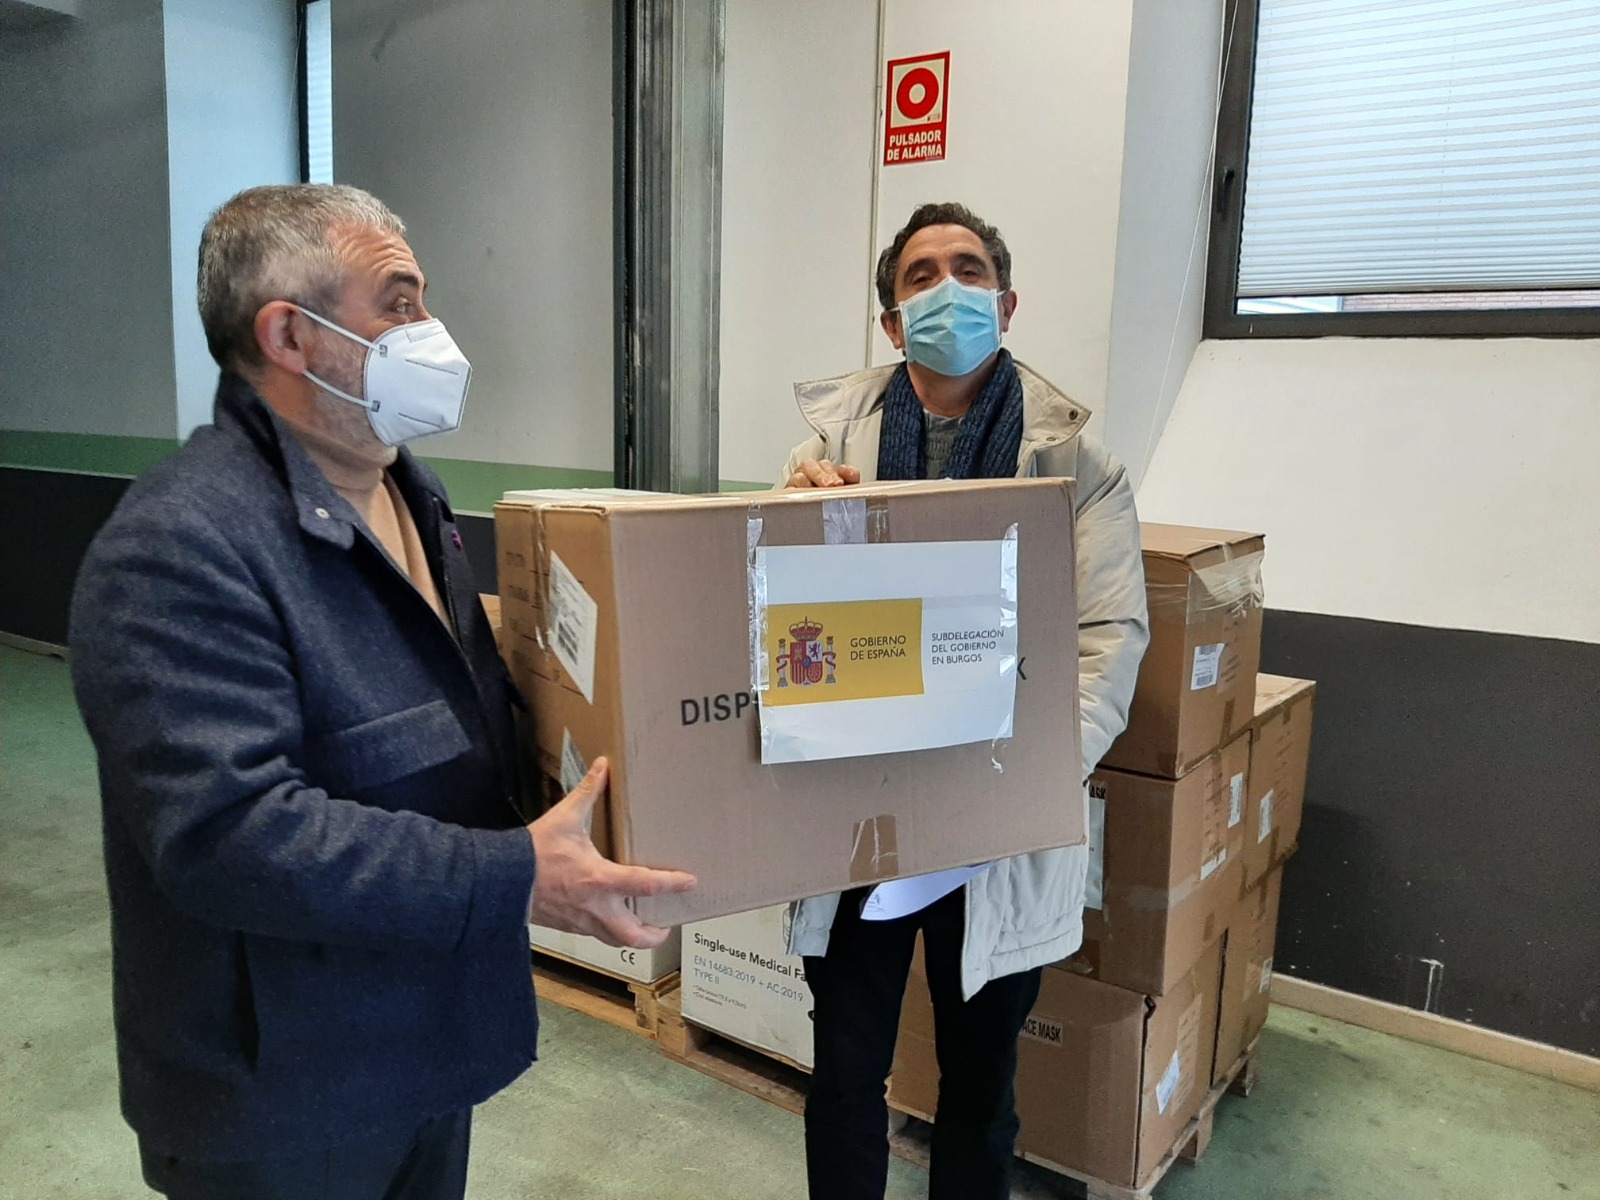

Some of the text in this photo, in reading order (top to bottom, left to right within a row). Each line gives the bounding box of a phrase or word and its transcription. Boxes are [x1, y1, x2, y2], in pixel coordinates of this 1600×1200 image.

[889, 129, 942, 147] PULSADOR
[886, 143, 943, 161] DE ALARMA
[850, 634, 907, 648] GOBIERNO
[931, 629, 1005, 641] SUBDELEGACIÓN
[850, 645, 907, 661] DE ESPAÑA
[931, 640, 997, 653] DEL GOBIERNO
[931, 653, 983, 665] EN BURGOS
[680, 691, 760, 727] DISP
[620, 949, 636, 966] CE
[694, 932, 747, 961] Single-use
[749, 951, 792, 977] Medical
[694, 967, 714, 983] TYPE
[694, 954, 706, 967] EN
[766, 981, 804, 1002] AC:2019
[1038, 1021, 1061, 1043] MASK
